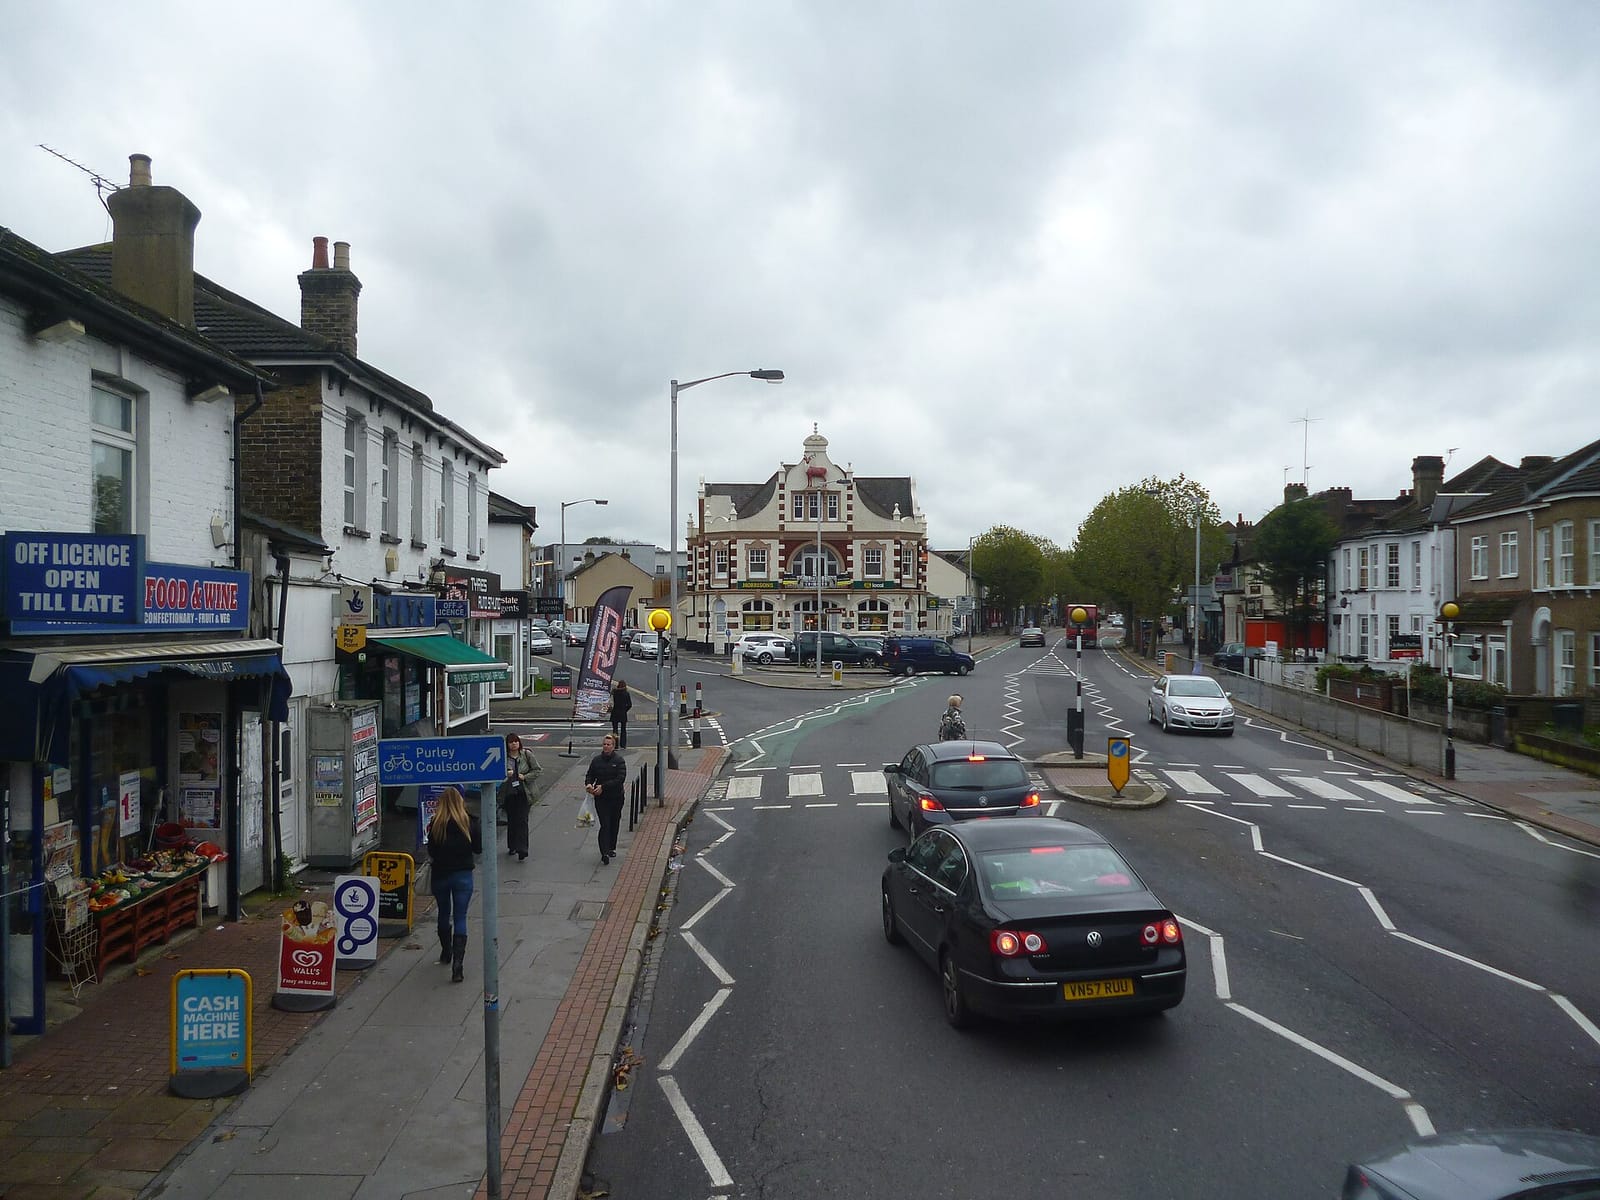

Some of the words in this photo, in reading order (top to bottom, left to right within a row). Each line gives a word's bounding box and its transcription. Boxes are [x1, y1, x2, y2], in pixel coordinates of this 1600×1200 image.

[15, 542, 48, 564] OFF
[52, 543, 130, 566] LICENCE
[45, 569, 100, 589] OPEN
[144, 576, 189, 610] FOOD
[191, 579, 202, 610] &
[203, 581, 239, 610] WINE
[19, 592, 65, 612] TILL
[71, 593, 125, 613] LATE
[500, 596, 518, 604] state
[436, 608, 465, 616] LICENCE
[501, 605, 520, 614] gents
[144, 612, 194, 624] CONFECTIONARY
[198, 613, 214, 624] FRUIT
[215, 614, 220, 624] &
[220, 613, 231, 623] VEG
[218, 661, 234, 673] LATE
[416, 747, 455, 759] Purley
[416, 761, 476, 773] Coulsdon
[121, 793, 129, 820] 1
[293, 967, 321, 976] WALL'S
[1070, 983, 1100, 997] VN57
[1104, 980, 1128, 994] RUU
[184, 996, 239, 1012] CASH
[184, 1012, 240, 1023] MACHINE
[184, 1022, 240, 1040] HERE
